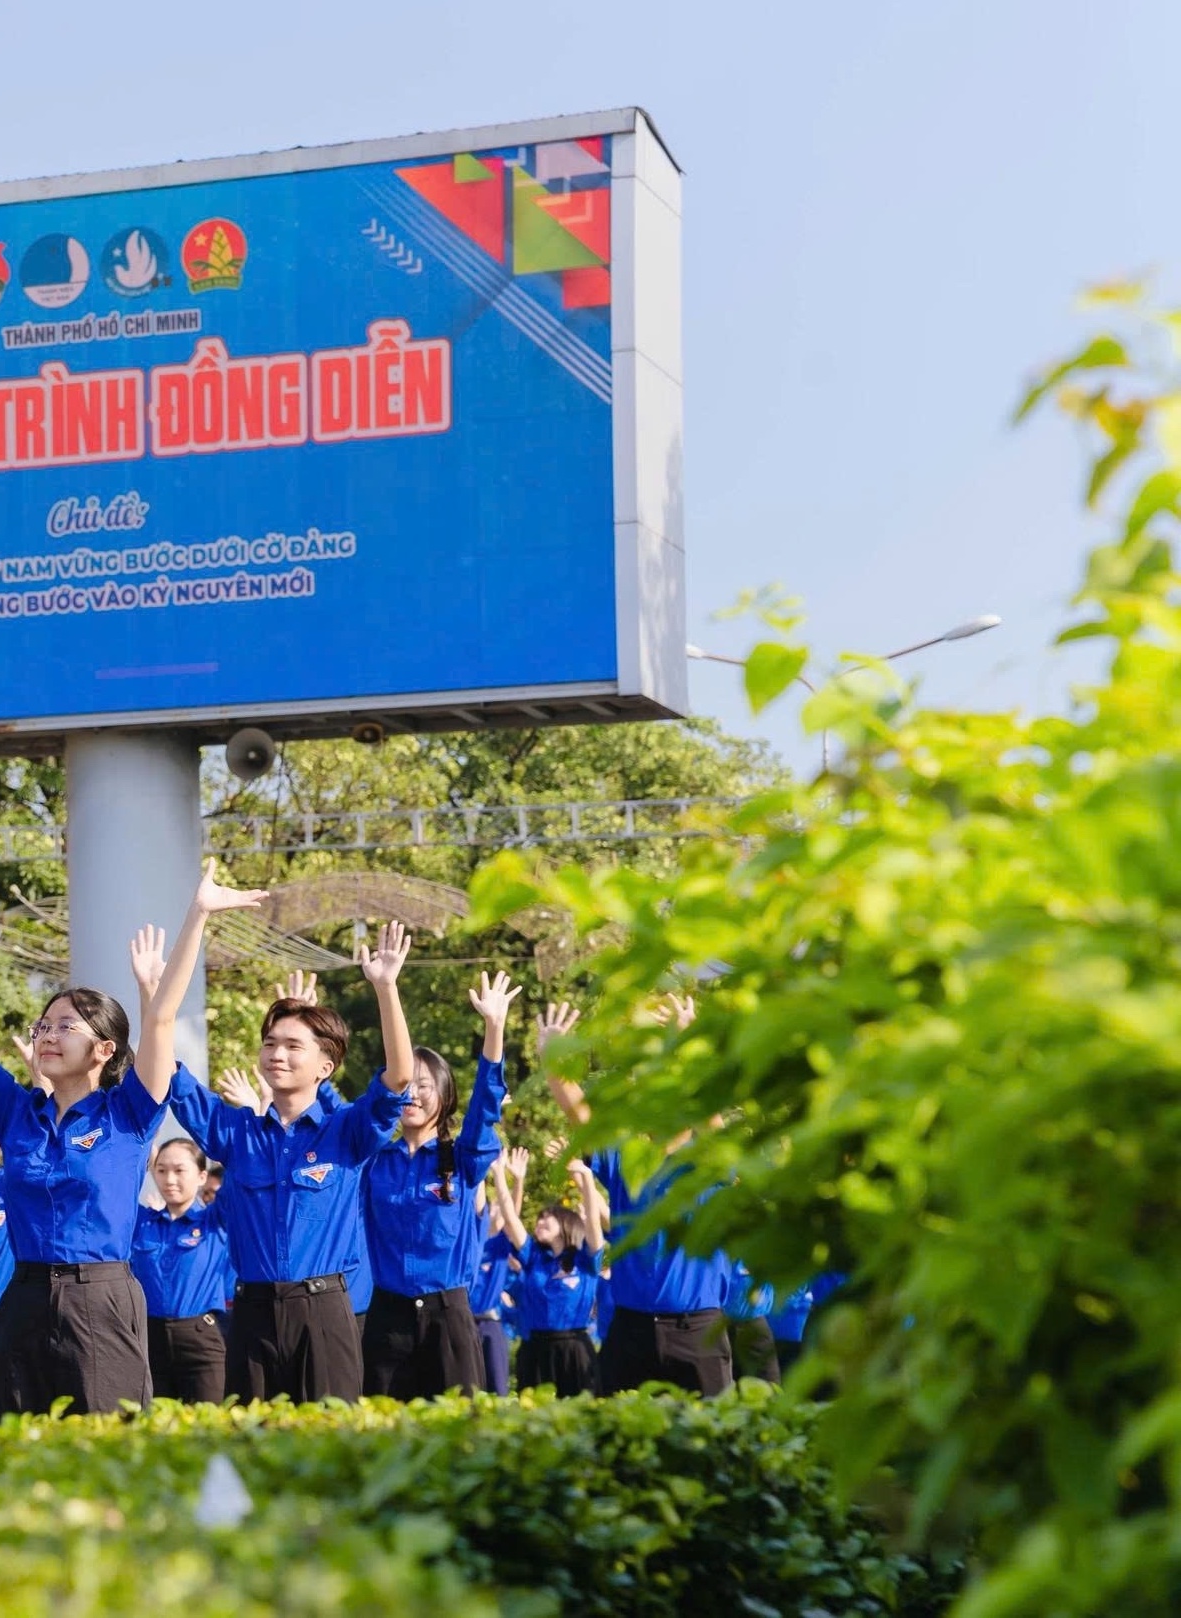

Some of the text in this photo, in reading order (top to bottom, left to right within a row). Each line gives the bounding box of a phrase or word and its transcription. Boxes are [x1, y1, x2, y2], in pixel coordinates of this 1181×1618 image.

[4, 323, 56, 347] THÀNH
[61, 314, 95, 341] PHỐ
[123, 312, 151, 335] CHÍ
[155, 311, 200, 332] MINH
[155, 343, 302, 450] ĐỒNG
[318, 326, 444, 437] DIỄN
[49, 498, 100, 535] Chủ
[5, 559, 53, 580] NAM
[59, 551, 119, 576] VỮNG
[125, 543, 186, 570] BƯỚC
[191, 538, 246, 566] DƯỚI
[252, 534, 285, 561] CỜ
[289, 529, 353, 558] ĐẢNG
[26, 586, 85, 613] BƯỚC
[91, 583, 136, 608] VÀO
[142, 578, 170, 605] KỶ
[176, 574, 263, 602] NGUYÊN
[269, 569, 312, 595] MỚI
